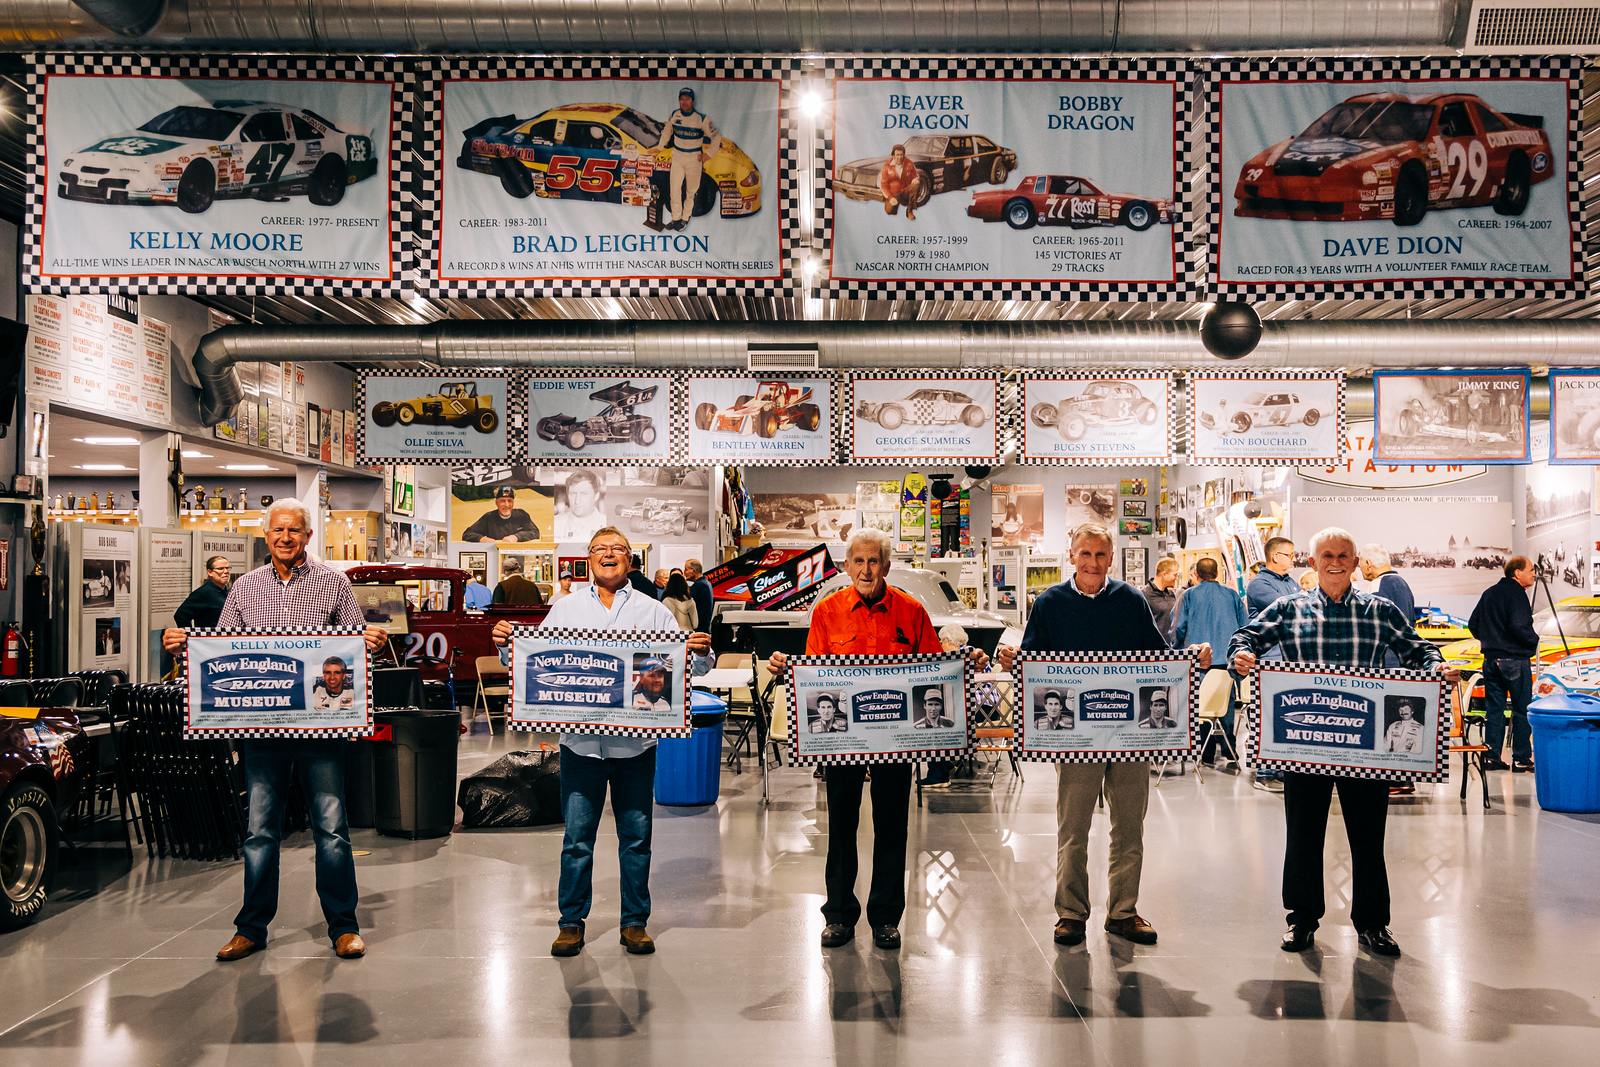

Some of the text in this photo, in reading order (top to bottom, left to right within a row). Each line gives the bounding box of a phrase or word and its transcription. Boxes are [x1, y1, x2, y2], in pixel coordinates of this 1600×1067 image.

[889, 96, 964, 110] BEAVER
[1059, 96, 1124, 111] BOBBY
[883, 114, 969, 130] DRAGON
[1047, 115, 1134, 131] DRAGON
[471, 139, 535, 162] Sheraton
[246, 143, 295, 183] 47
[546, 155, 618, 192] 55
[1245, 168, 1263, 181] 29
[1445, 140, 1487, 200] 29
[261, 216, 305, 226] CAREER:
[336, 217, 380, 227] PRESENT
[459, 217, 548, 228] CAREER: 1983-2011
[1458, 220, 1551, 229] CAREER: 1964-2007
[129, 231, 303, 252] KELLY MOORE
[512, 235, 709, 253] BRAD LEIGHTON
[877, 235, 968, 245] CAREER: 1957-1999
[1032, 236, 1124, 246] CAREER: 1965-2011
[1323, 237, 1463, 256] DAVE DION
[895, 250, 950, 259] 1979 & 1980
[1035, 251, 1121, 260] 145 VICTORIES AT
[52, 258, 380, 270] ALL-TIME WINS LEADER IN NASCAR BUSCH NORTH WITH 27 WINS
[448, 260, 773, 271] A RECORD 8 WINS AT NHIS WITH THE NASCAR BUSCH NORTH SERIES
[855, 262, 989, 272] NASCAR NORTH CHAMPION
[1051, 263, 1105, 272] 29 TRACKS
[1237, 263, 1551, 275] RACED FOR 43 YEARS WITH A VOLUNTEER FAMILY RACE TEAM.
[1458, 382, 1519, 390] JIMMY KING
[1559, 381, 1585, 390] JACK
[627, 394, 642, 405] 61
[1118, 402, 1130, 417] 3
[1269, 406, 1292, 424] 47
[405, 439, 464, 447] OLLIE SILVA
[876, 437, 970, 445] GEORGE SUMMERS
[796, 549, 826, 592] 27
[754, 571, 786, 593] Shea
[757, 581, 792, 602] CONCRETE
[231, 640, 321, 650] KELLY MOORE
[405, 632, 448, 663] 20
[549, 638, 650, 649] BRAD LEIGHTON
[207, 657, 298, 675] New England
[534, 654, 618, 672] New England
[818, 664, 940, 678] DRAGON BROTHERS
[1047, 665, 1168, 674] DRAGON BROTHERS
[230, 680, 294, 689] RACING
[553, 676, 615, 686] RACING
[1314, 676, 1385, 690] DAVE DION
[1537, 683, 1554, 694] 55
[538, 690, 610, 703] MUSEUM
[856, 692, 903, 703] New England
[1100, 691, 1130, 700] England
[214, 696, 291, 708] MUSEUM
[1280, 693, 1368, 713] New England
[1302, 714, 1365, 727] RACING
[1286, 729, 1361, 745] MUSEUM
